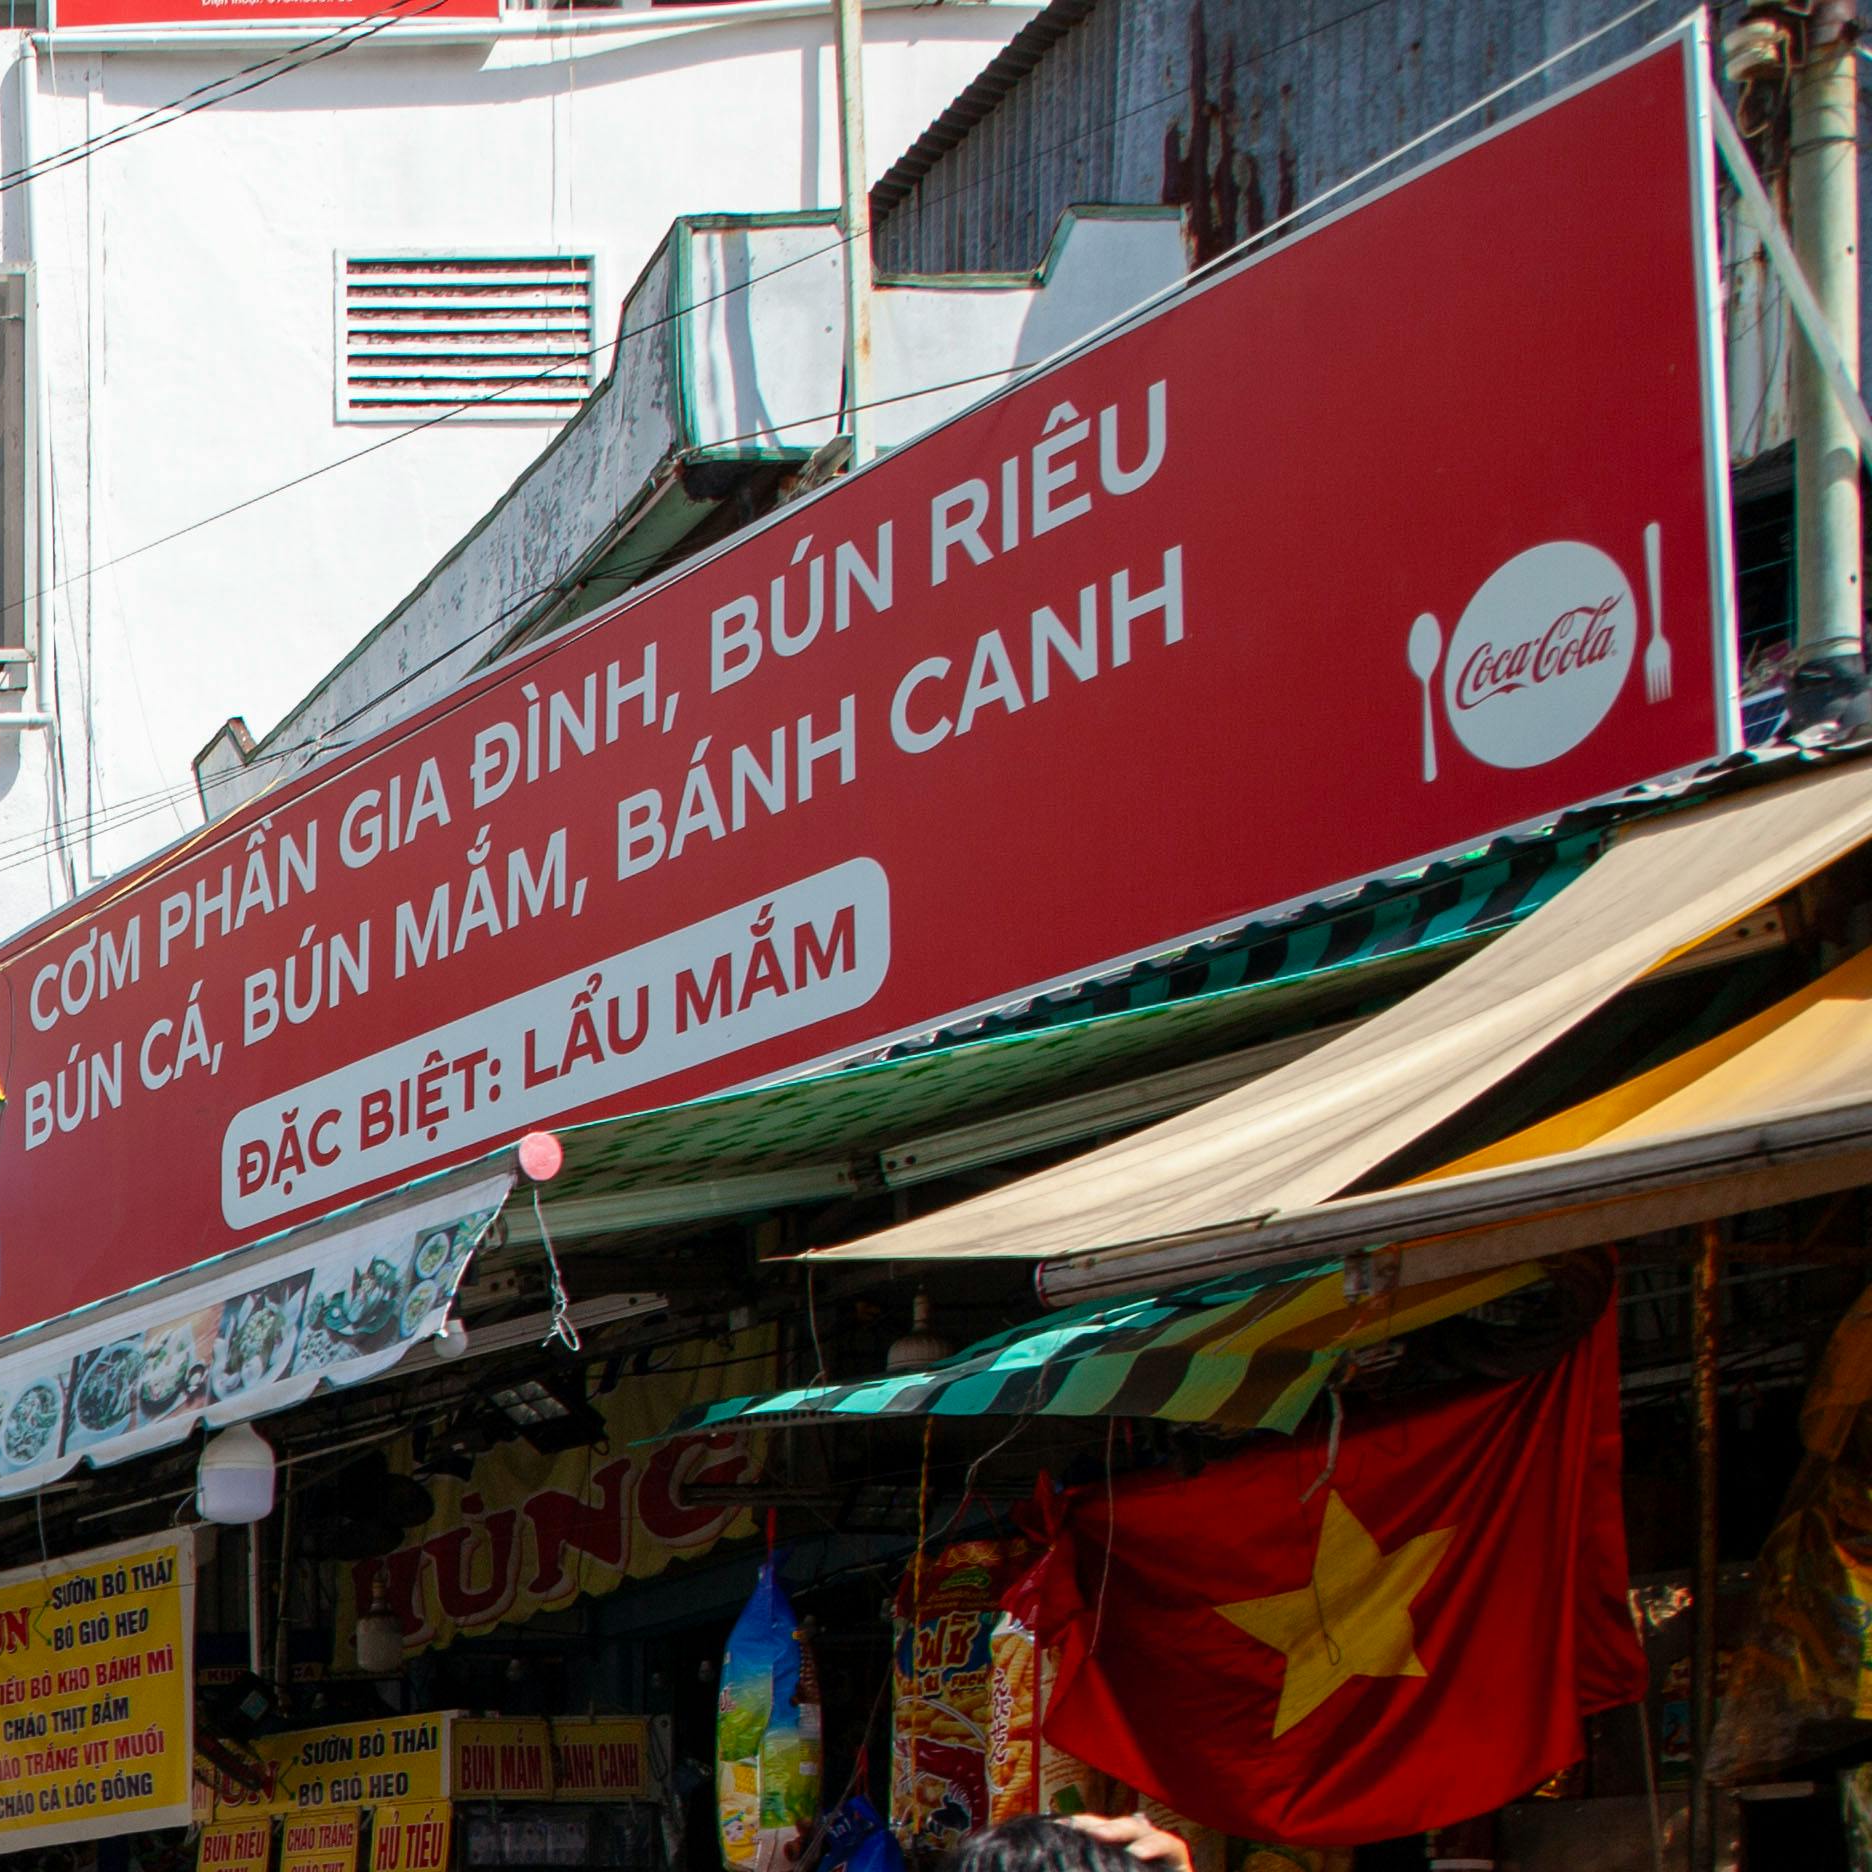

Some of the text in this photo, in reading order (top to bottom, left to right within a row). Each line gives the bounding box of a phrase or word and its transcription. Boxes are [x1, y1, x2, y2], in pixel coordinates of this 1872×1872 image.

[1455, 590, 1626, 713] Coca-Cola
[28, 379, 1168, 1032] CƠM PHẦN GIA ĐÌNH, BÚN RIÊU
[25, 545, 1185, 1151] BÚN CÁ, BÚN MẮM, BÁNH CANH
[236, 902, 857, 1198] ĐẶC BIỆT: LẨU MẮM
[52, 1558, 173, 1610] SƯỜN BÒ THÁI
[78, 1614, 110, 1645] GIÒ
[115, 1606, 149, 1638] HEO
[31, 1669, 52, 1700] BÒ
[57, 1666, 90, 1696] KHO
[95, 1655, 141, 1687] BÁNH
[146, 1643, 174, 1674] MÌ
[3, 1710, 47, 1742] CHÁO
[51, 1704, 87, 1736] THỊT
[82, 1740, 109, 1770] VỊT
[113, 1723, 165, 1761] MUỐI
[301, 1721, 438, 1767] SƯỜN BÒ THÁI
[368, 1771, 409, 1799] HEO
[461, 1734, 496, 1791] BÚN
[599, 1743, 641, 1788] CANH
[39, 1783, 61, 1814] CÁ
[64, 1778, 97, 1808] LÓC
[100, 1769, 153, 1801] ĐỒNG
[202, 1824, 266, 1864] BÚN RIÊU
[287, 1820, 315, 1852] CHÁO
[375, 1807, 445, 1872] HỦ TIẾU
